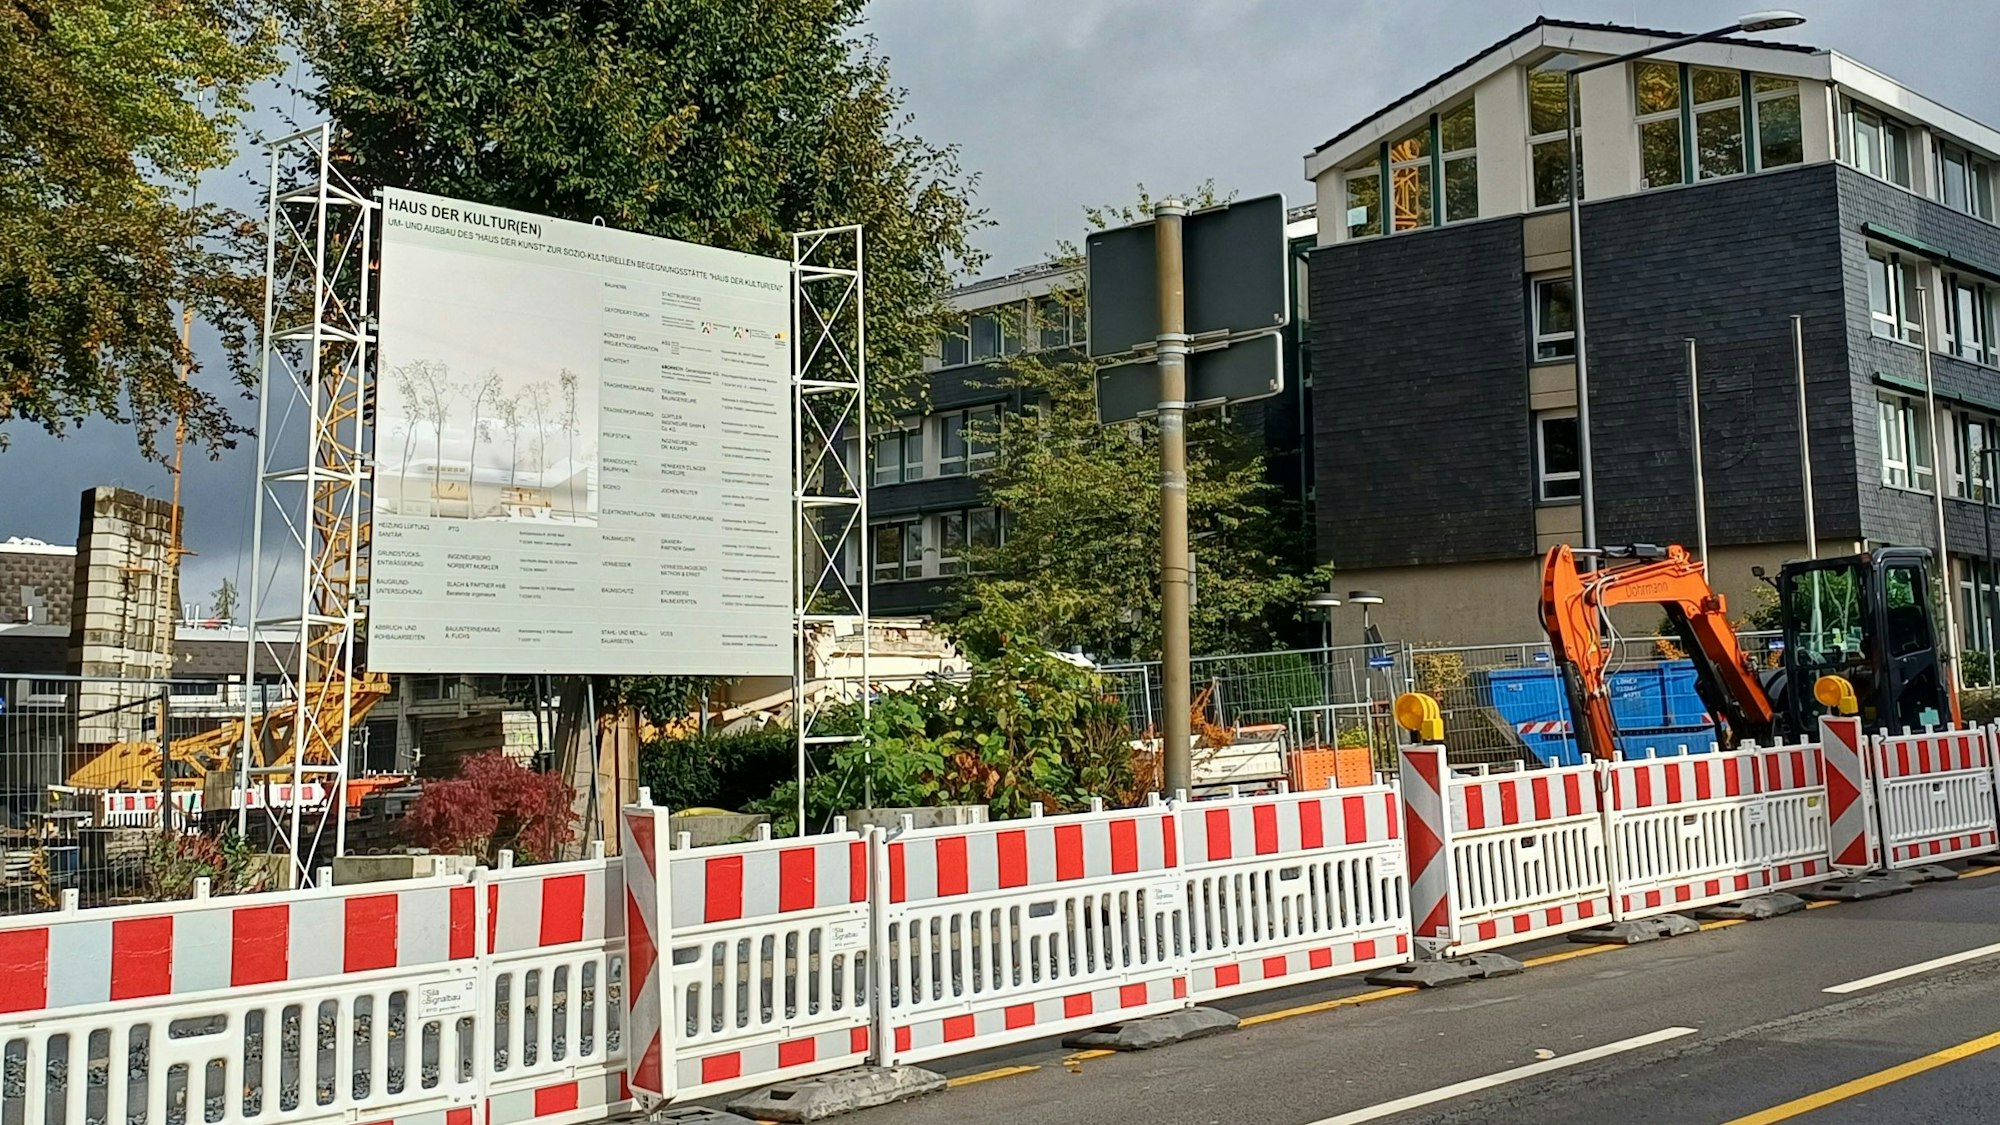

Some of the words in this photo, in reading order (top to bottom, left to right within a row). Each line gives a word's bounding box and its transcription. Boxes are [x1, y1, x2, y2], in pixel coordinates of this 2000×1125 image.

[389, 198, 427, 215] HAUS
[431, 205, 459, 222] DER
[464, 211, 542, 238] KULTUR(EN)
[388, 218, 404, 227] UM-
[405, 220, 422, 231] UND
[424, 224, 456, 237] AUSBAU
[457, 229, 474, 239] DES
[500, 237, 517, 247] DER
[547, 245, 562, 254] ZUR
[563, 248, 636, 267] SOZIO-KULTURELLEN
[637, 261, 708, 279] BEGEGNUNGSSTÄTTE
[730, 277, 744, 285] DER
[378, 522, 403, 530] HEIZUNG
[404, 523, 430, 531] LÜFTUNG
[447, 562, 473, 570] NORBERT
[470, 581, 495, 589] PARTNER
